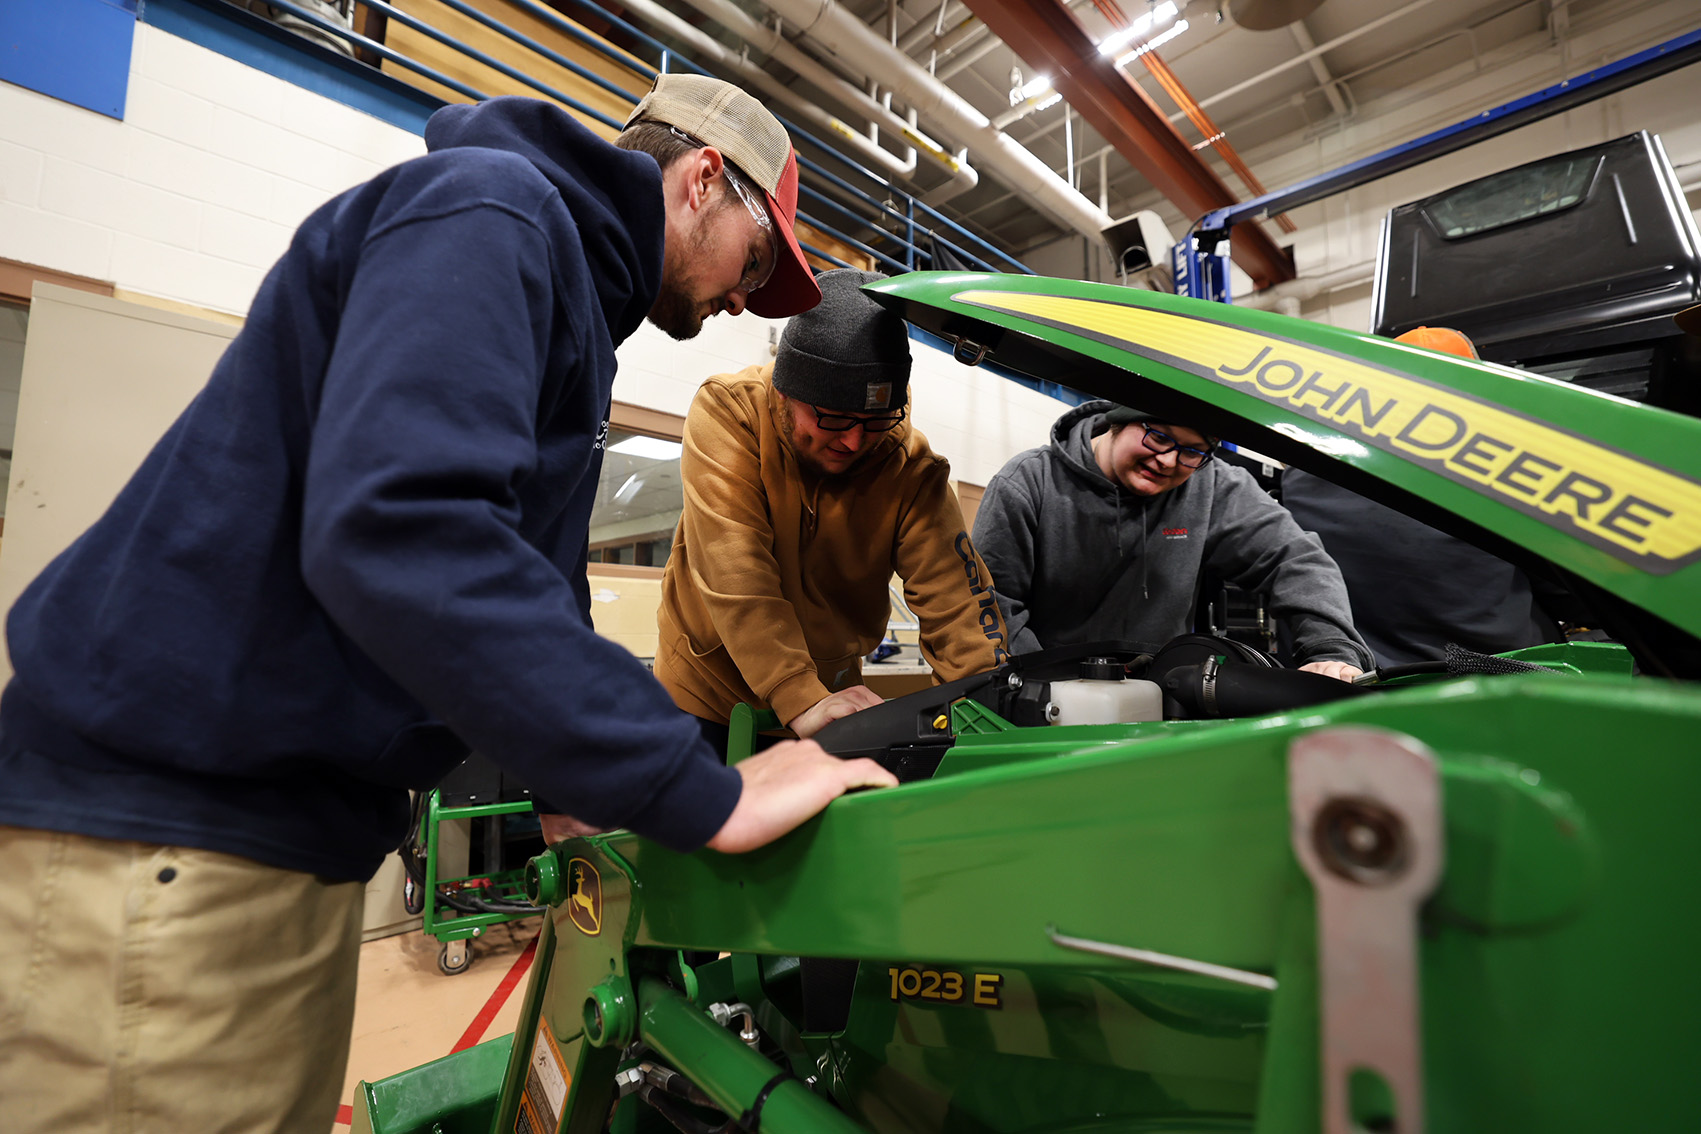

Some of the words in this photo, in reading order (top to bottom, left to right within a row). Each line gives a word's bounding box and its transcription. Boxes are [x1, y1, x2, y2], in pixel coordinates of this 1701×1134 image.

[1174, 242, 1188, 281] LIFT
[1218, 345, 1398, 430] JOHN
[1395, 402, 1674, 545] DEERE
[888, 967, 964, 1001] 1023
[973, 973, 1001, 1006] E
